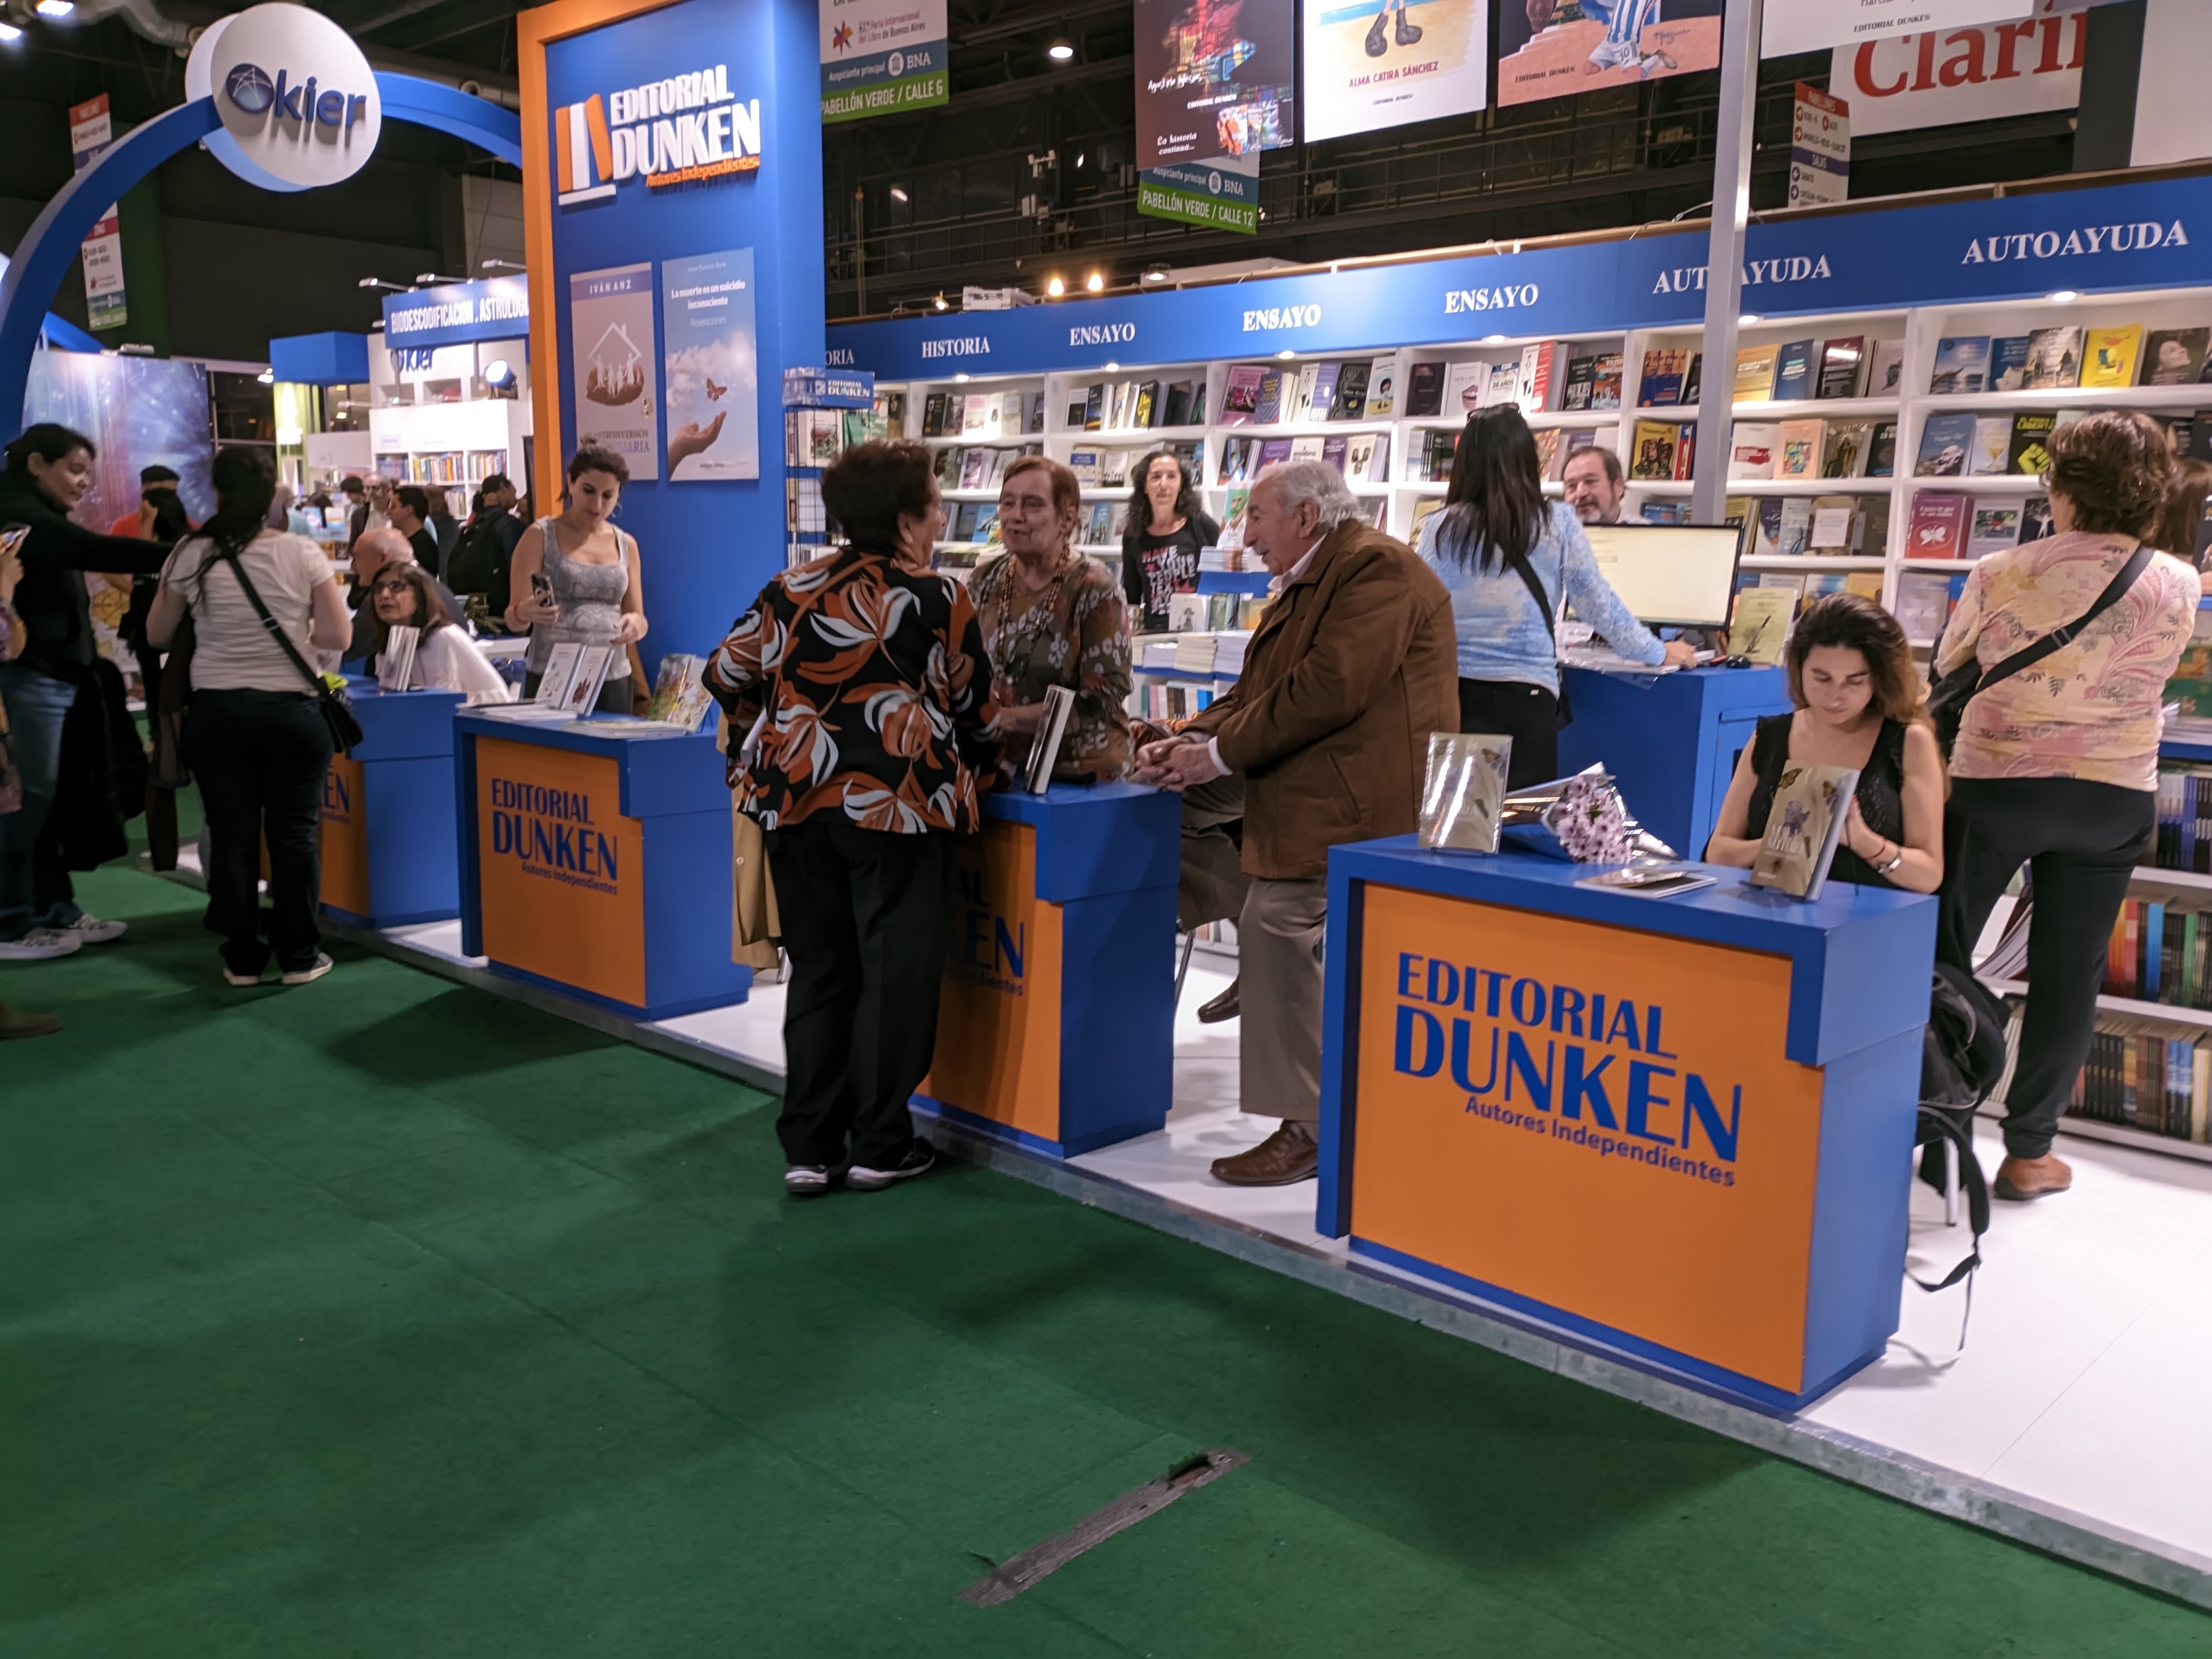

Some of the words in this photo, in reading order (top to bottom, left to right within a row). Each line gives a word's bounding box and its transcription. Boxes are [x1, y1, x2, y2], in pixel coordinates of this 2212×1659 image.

[890, 26, 909, 37] Buenos
[910, 22, 926, 33] Aires
[1853, 19, 1894, 33] EDITORIAL
[1897, 14, 1931, 26] DUNKEN
[829, 67, 861, 83] Auspiciante
[861, 62, 886, 78] principal
[907, 52, 931, 69] BNA
[1349, 75, 1370, 88] ALMA
[1373, 69, 1399, 83] CATIRA
[1515, 70, 1547, 83] EDITORIAL
[1549, 66, 1575, 77] DUNKEN
[610, 64, 735, 127] EDITORIAL
[821, 91, 863, 116] PABELLÓN
[865, 88, 895, 108] VERDE
[905, 81, 934, 101] CALLE
[611, 98, 761, 180] DUNKEN
[1157, 135, 1167, 146] La
[1169, 131, 1197, 144] historia
[1153, 166, 1183, 181] Auspiciante
[1184, 172, 1206, 186] principal
[1224, 179, 1244, 197] BNA
[1143, 189, 1183, 213] PABELLÓN
[1185, 199, 1210, 218] VERDE
[1218, 205, 1242, 224] CALLE
[1243, 210, 1254, 227] 12
[1961, 219, 2190, 265] AUTOAYUDA
[1652, 254, 1832, 294] AUTAYUDA
[589, 281, 611, 295] IVÁN
[613, 279, 632, 291] ANZ
[671, 289, 679, 299] La
[679, 285, 703, 298] muerte
[703, 285, 710, 295] es
[710, 284, 719, 293] un
[719, 279, 745, 292] suicidio
[1444, 283, 1539, 314] ENSAYO
[390, 299, 474, 335] BIODESCODIFICACION
[479, 292, 529, 323] ASTROLOGI
[687, 296, 729, 310] inconsciente
[1242, 304, 1322, 332] ENSAYO
[1069, 322, 1136, 347] ENSAYO
[825, 349, 855, 366] ORIA
[922, 336, 991, 359] HISTORIA
[827, 380, 862, 388] EDITORIAL
[827, 386, 871, 398] DUNKEN
[491, 777, 595, 825] EDITORIAL
[493, 810, 617, 881] DUNKEN
[521, 861, 552, 879] Autores
[553, 869, 618, 896] Independientes
[1397, 951, 1679, 1061] EDITORIAL
[1393, 1003, 1742, 1163] DUNKEN
[1465, 1095, 1547, 1134] Autores
[1551, 1120, 1736, 1187] Independientes
